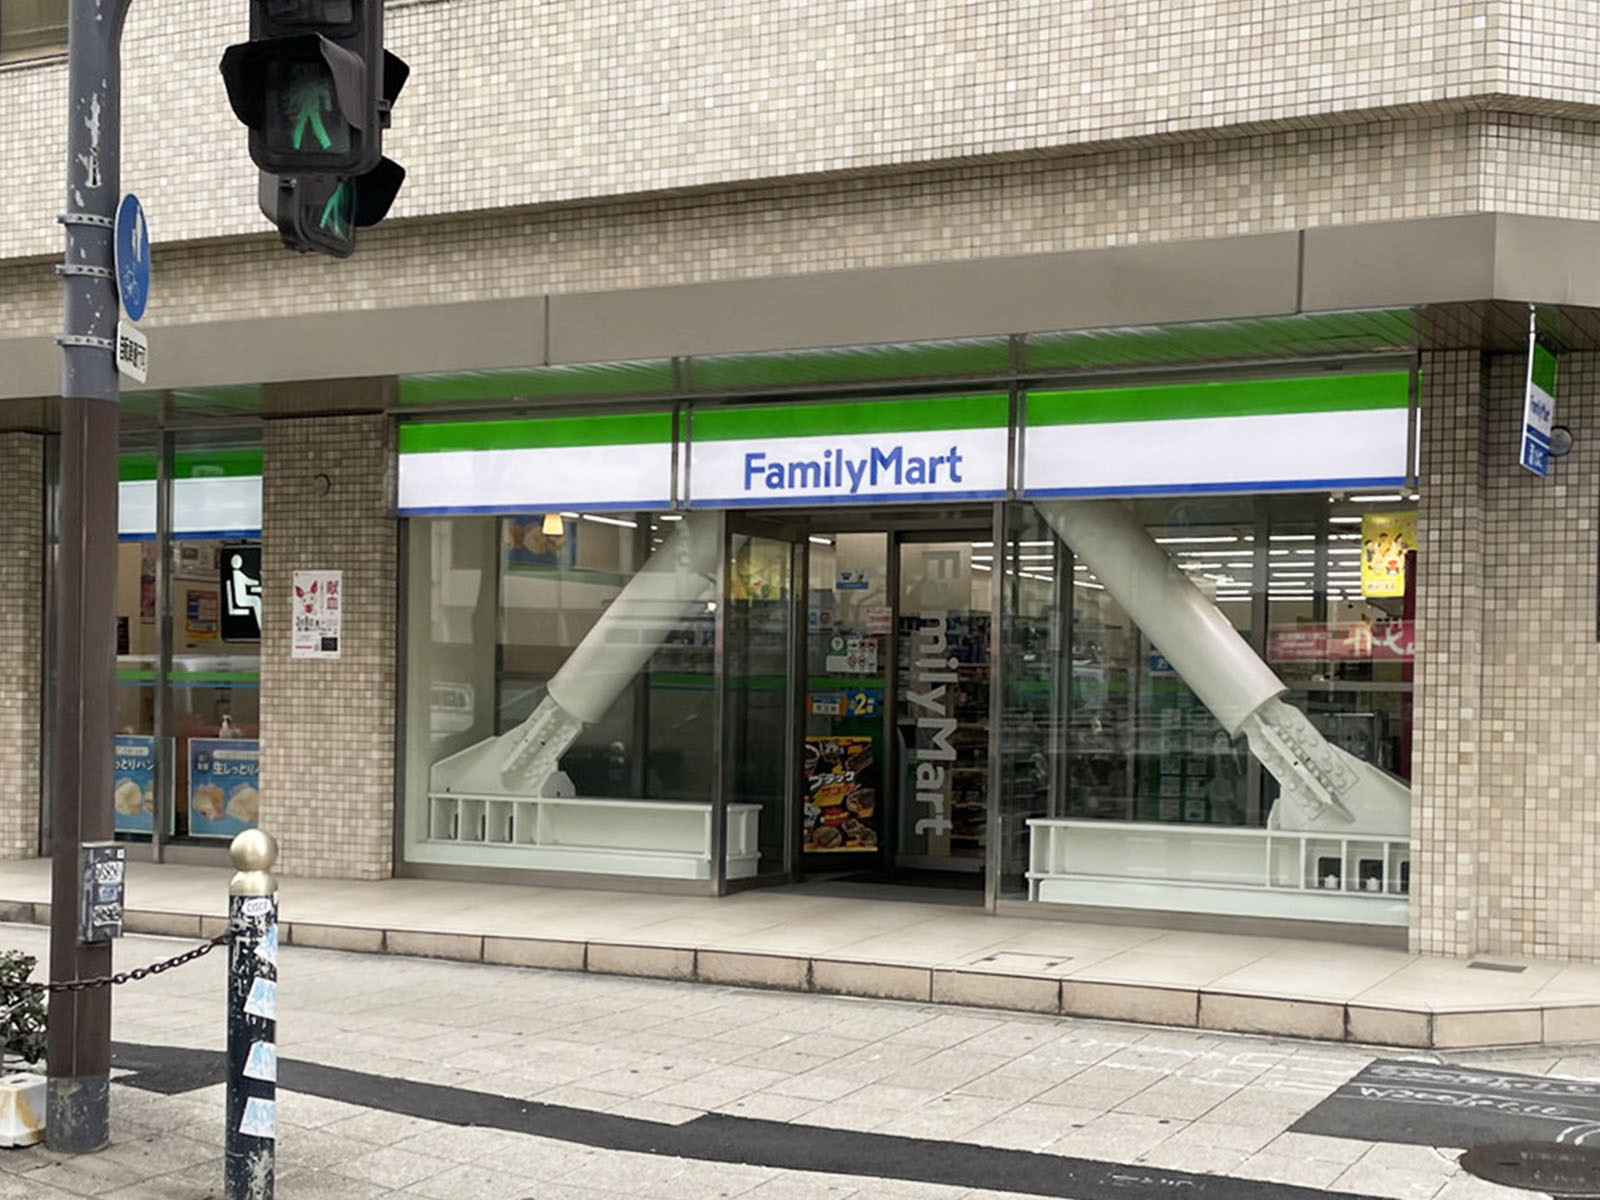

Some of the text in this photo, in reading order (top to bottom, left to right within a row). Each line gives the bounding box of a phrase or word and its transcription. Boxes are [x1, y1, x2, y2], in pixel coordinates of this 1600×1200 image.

[744, 446, 963, 493] FamilyMart
[906, 551, 960, 835] FmilyMart
[808, 771, 855, 791] ブラック
